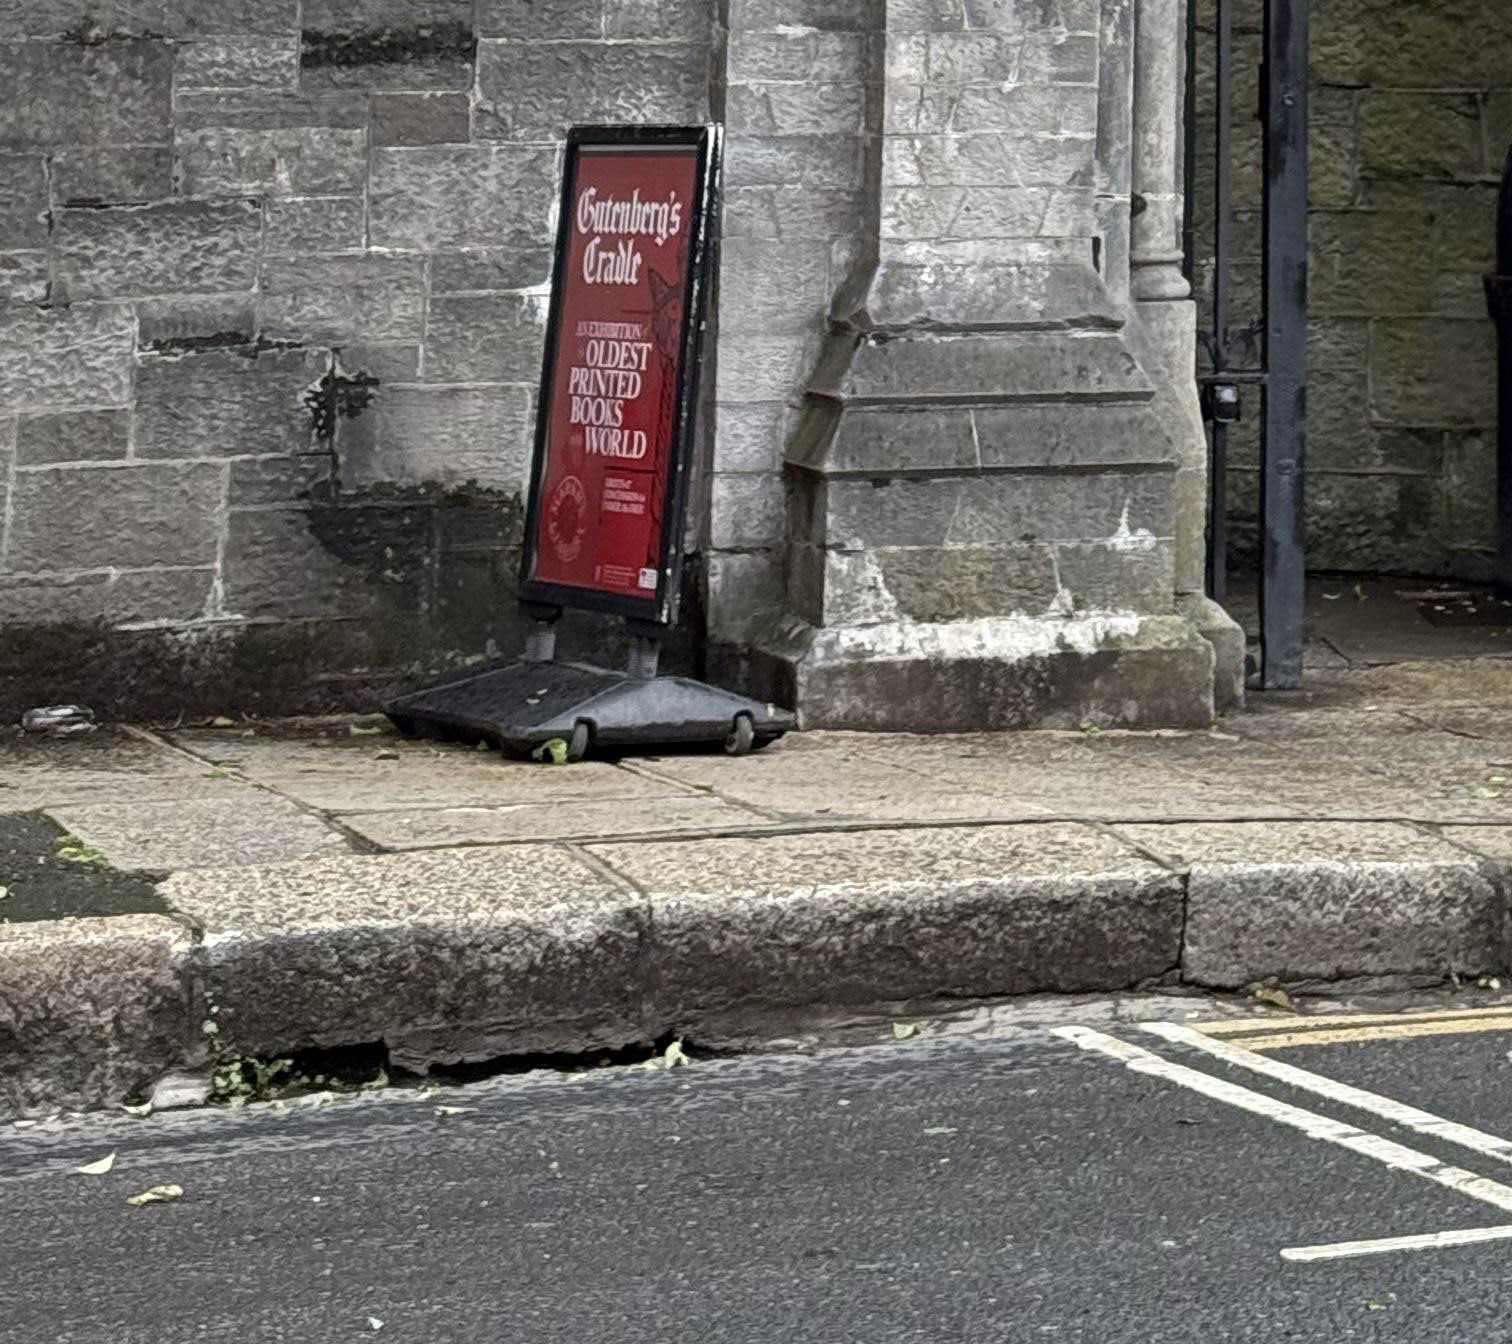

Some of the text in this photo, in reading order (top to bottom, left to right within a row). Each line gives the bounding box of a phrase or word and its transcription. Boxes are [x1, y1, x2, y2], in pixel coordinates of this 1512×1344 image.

[577, 185, 683, 247] Gutenberg's
[583, 236, 642, 285] Cradle
[586, 339, 653, 371] OLDEST
[569, 367, 642, 400] PRINTED
[570, 395, 625, 428] BOOKS
[585, 425, 648, 460] WORLD
